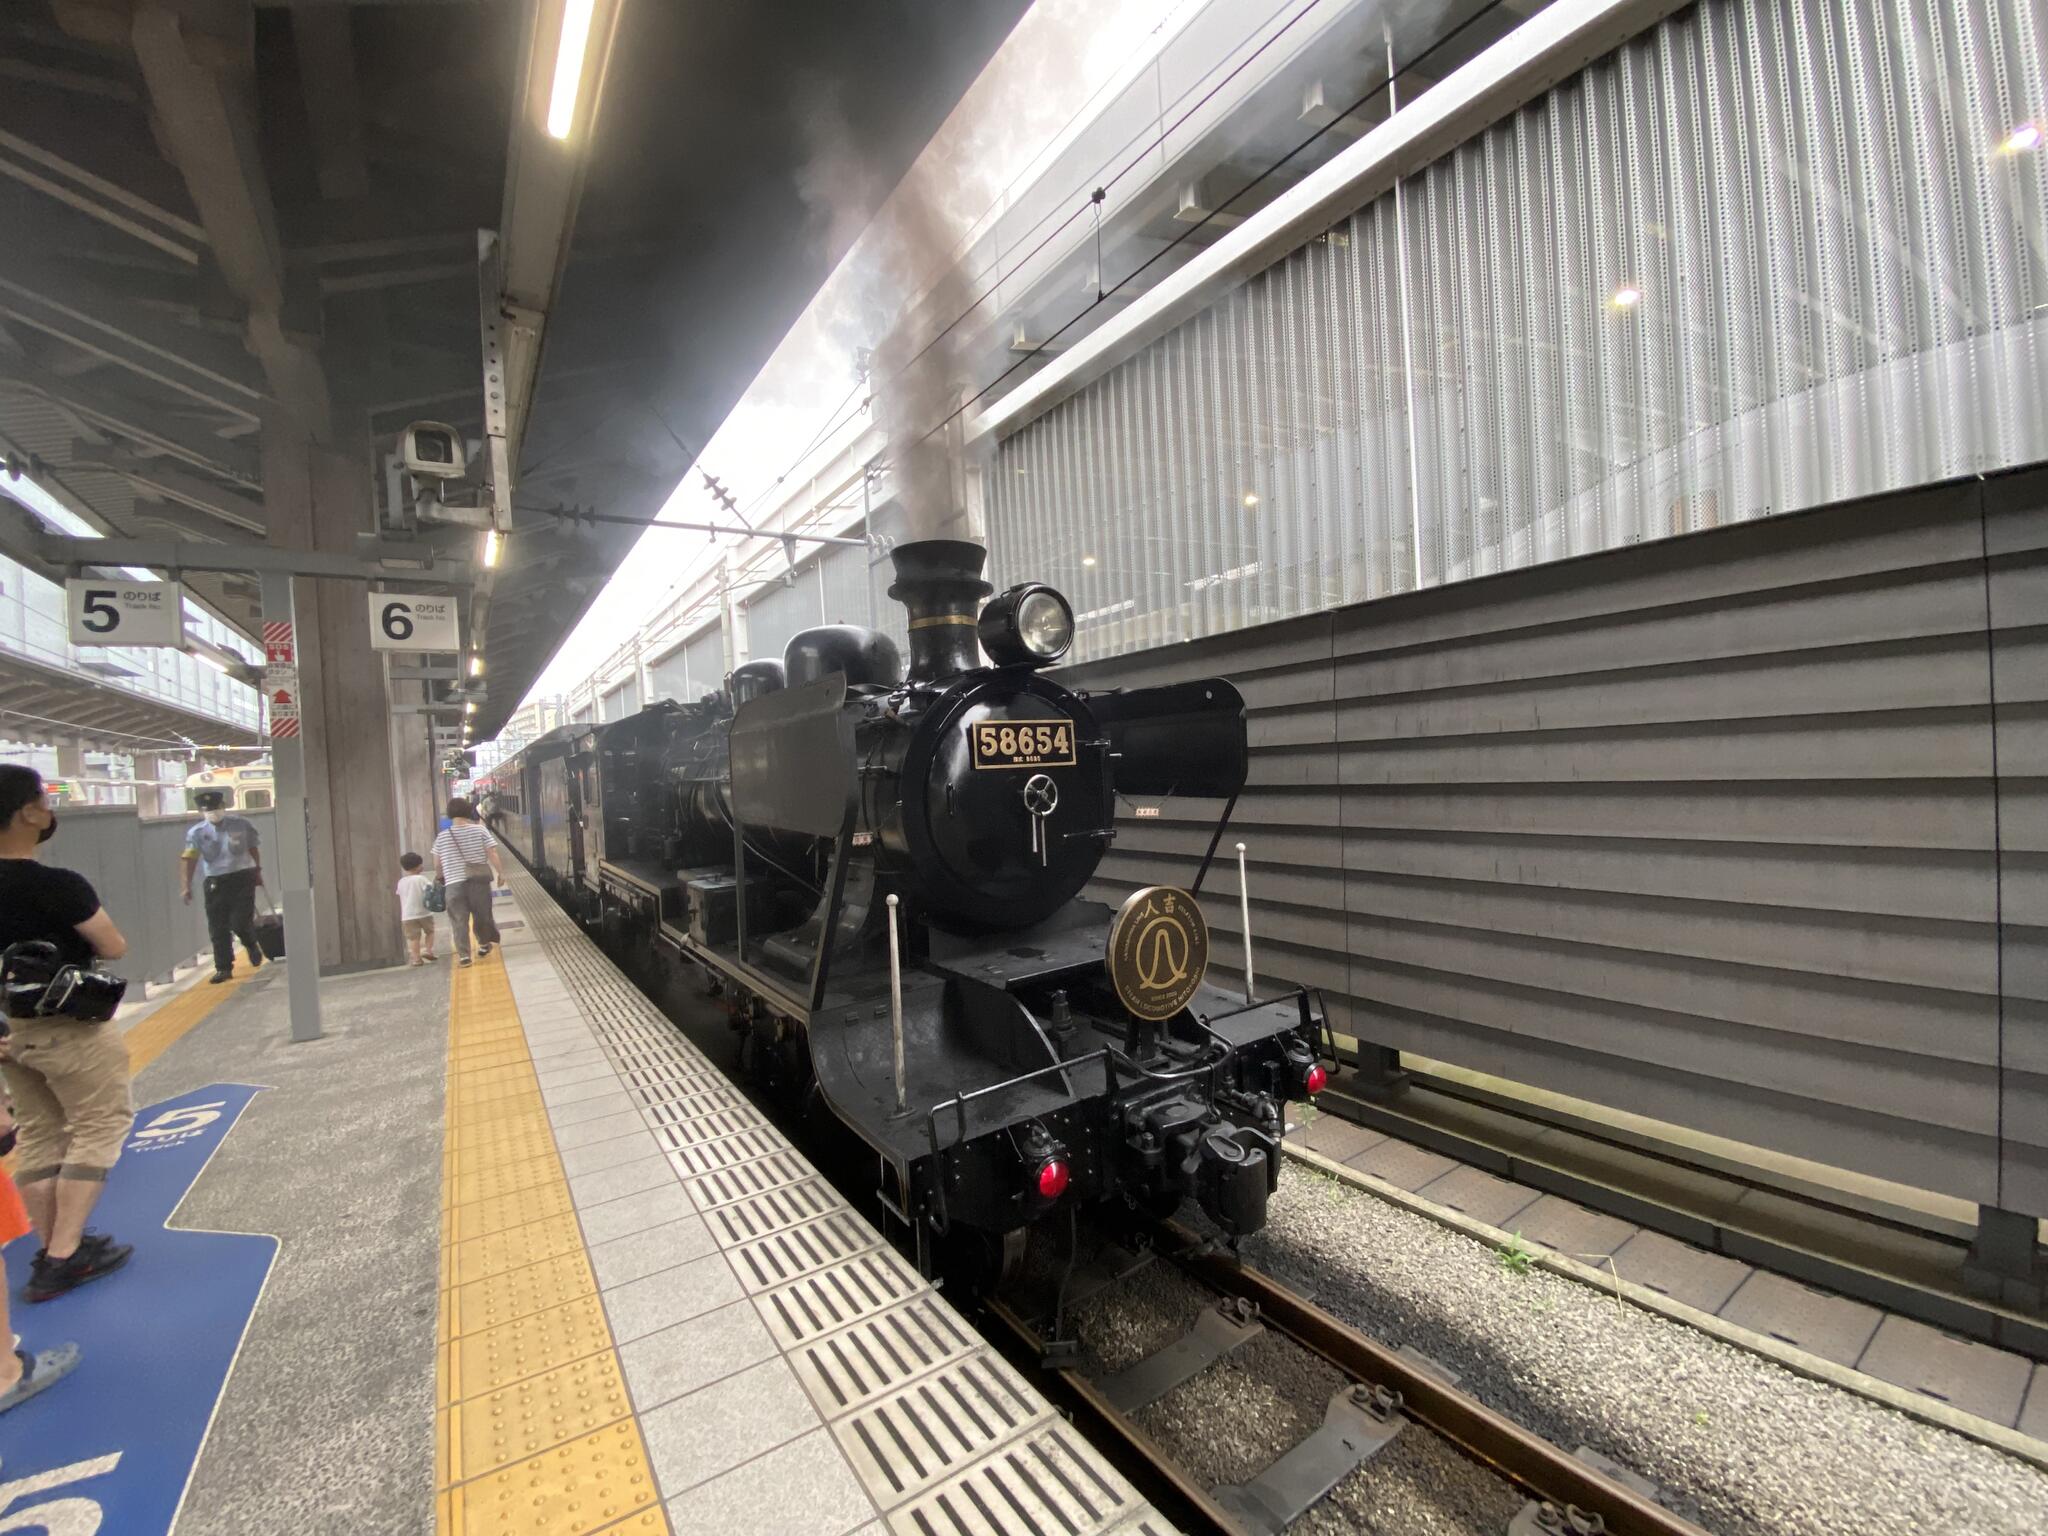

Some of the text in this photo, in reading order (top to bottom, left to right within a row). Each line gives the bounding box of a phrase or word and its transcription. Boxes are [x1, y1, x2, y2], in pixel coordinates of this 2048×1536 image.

[123, 591, 161, 602] のりば
[415, 604, 446, 614] のりば
[82, 590, 120, 633] 5
[382, 602, 414, 641] 6
[980, 726, 1070, 757] 58654
[1143, 892, 1176, 919] 人吉
[135, 1101, 226, 1138] 5
[127, 1129, 207, 1149] のりば
